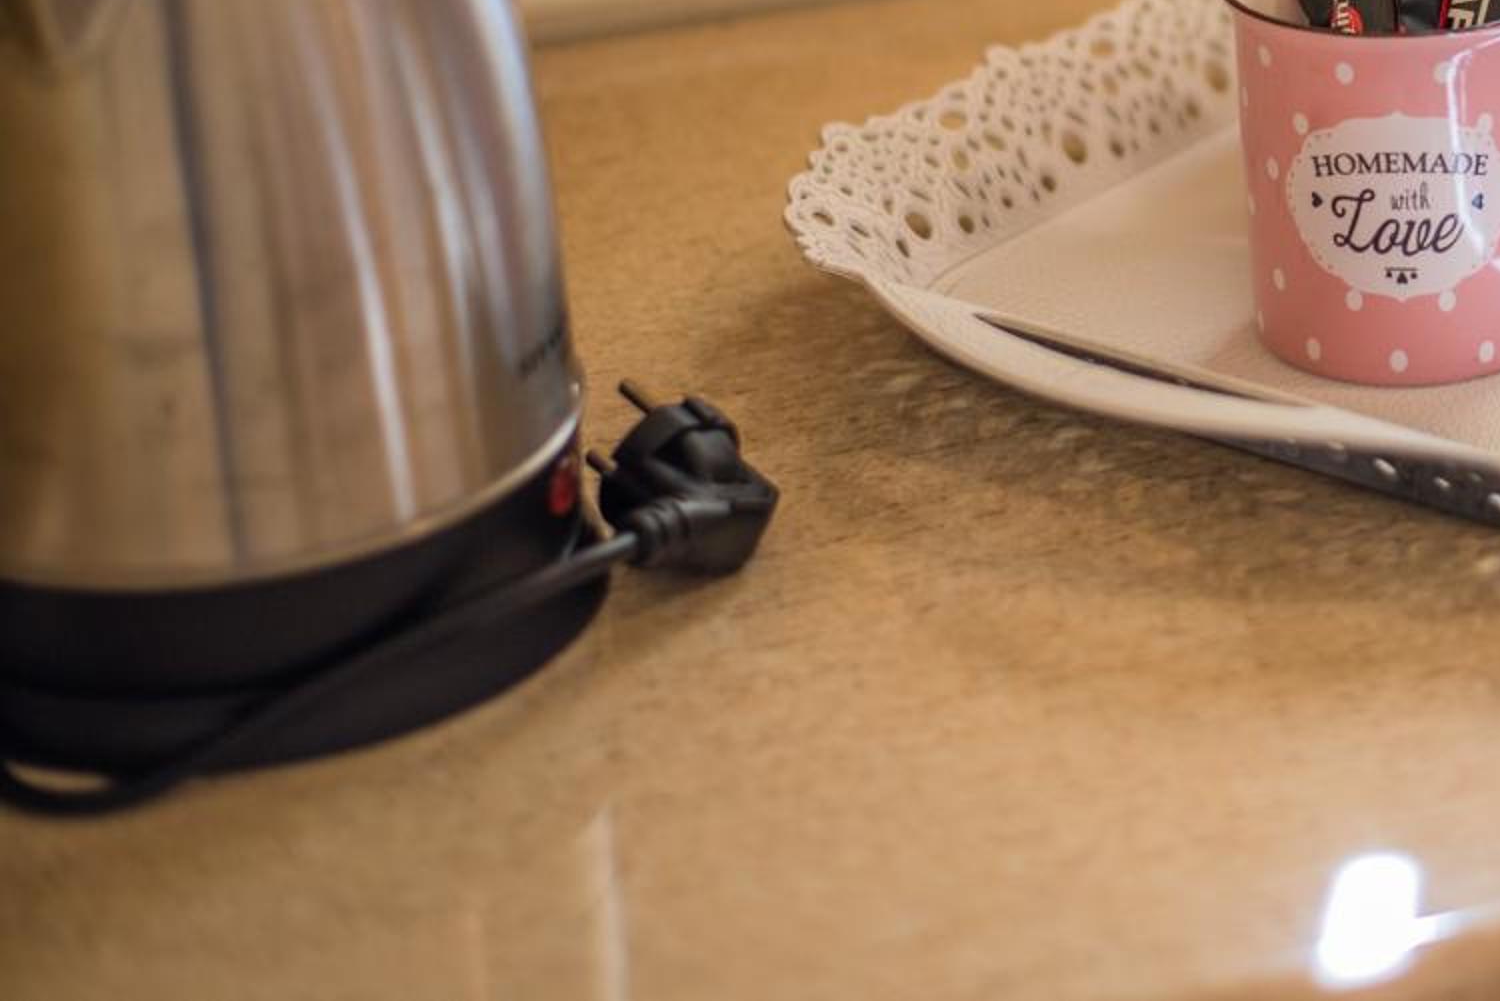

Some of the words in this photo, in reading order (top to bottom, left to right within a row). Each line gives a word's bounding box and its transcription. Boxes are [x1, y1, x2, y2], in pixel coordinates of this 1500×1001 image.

[1311, 152, 1488, 177] HOMEMADE
[1391, 182, 1430, 210] with
[1331, 188, 1464, 256] Love
